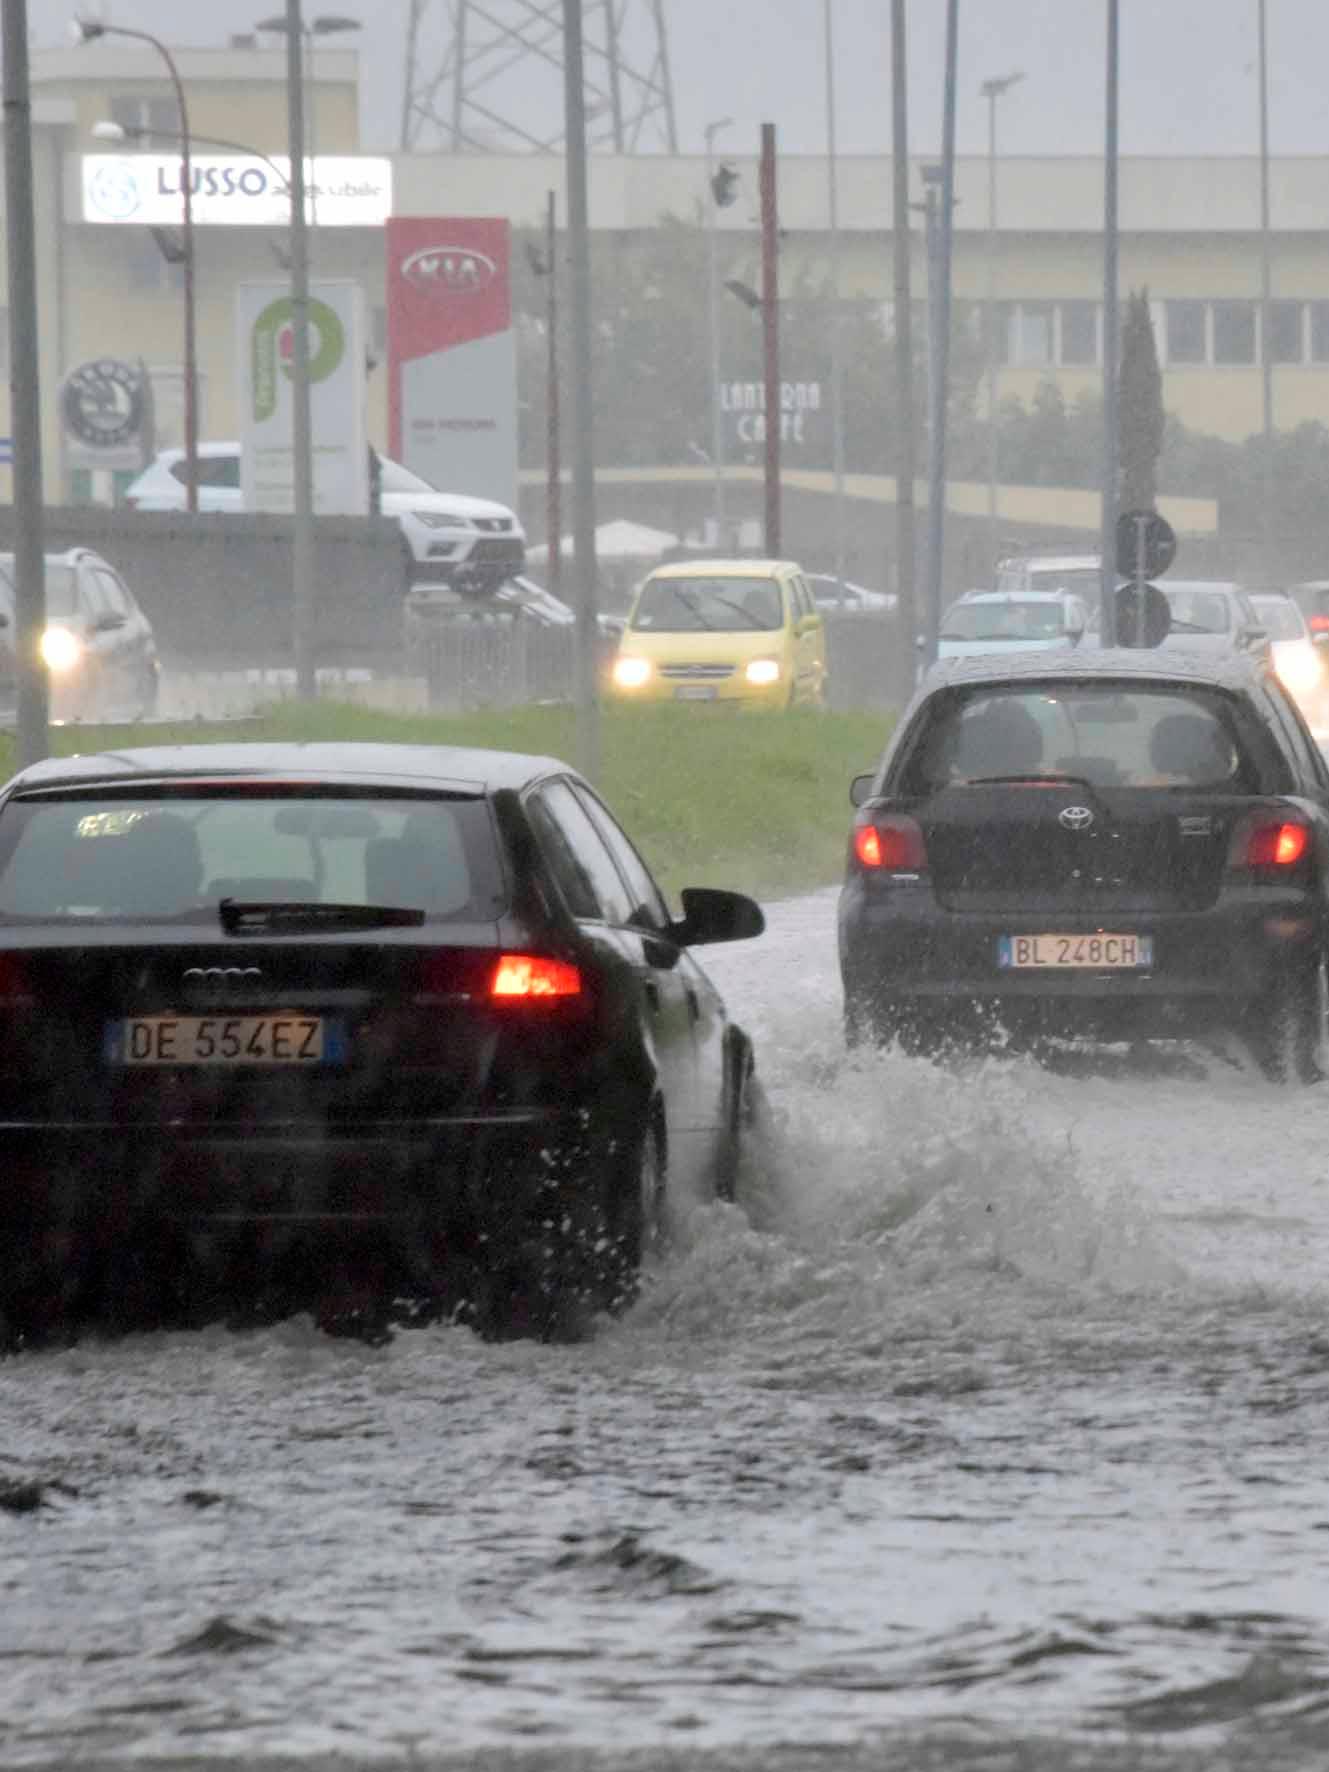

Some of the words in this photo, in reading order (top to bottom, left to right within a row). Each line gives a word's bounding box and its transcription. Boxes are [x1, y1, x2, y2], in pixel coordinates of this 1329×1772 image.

[157, 167, 268, 197] LUSSO
[720, 382, 820, 410] LANTRNA
[1015, 938, 1046, 964] BL
[1056, 938, 1136, 964] 248CH
[130, 1021, 178, 1060] DE
[194, 1019, 321, 1059] 554EZ
